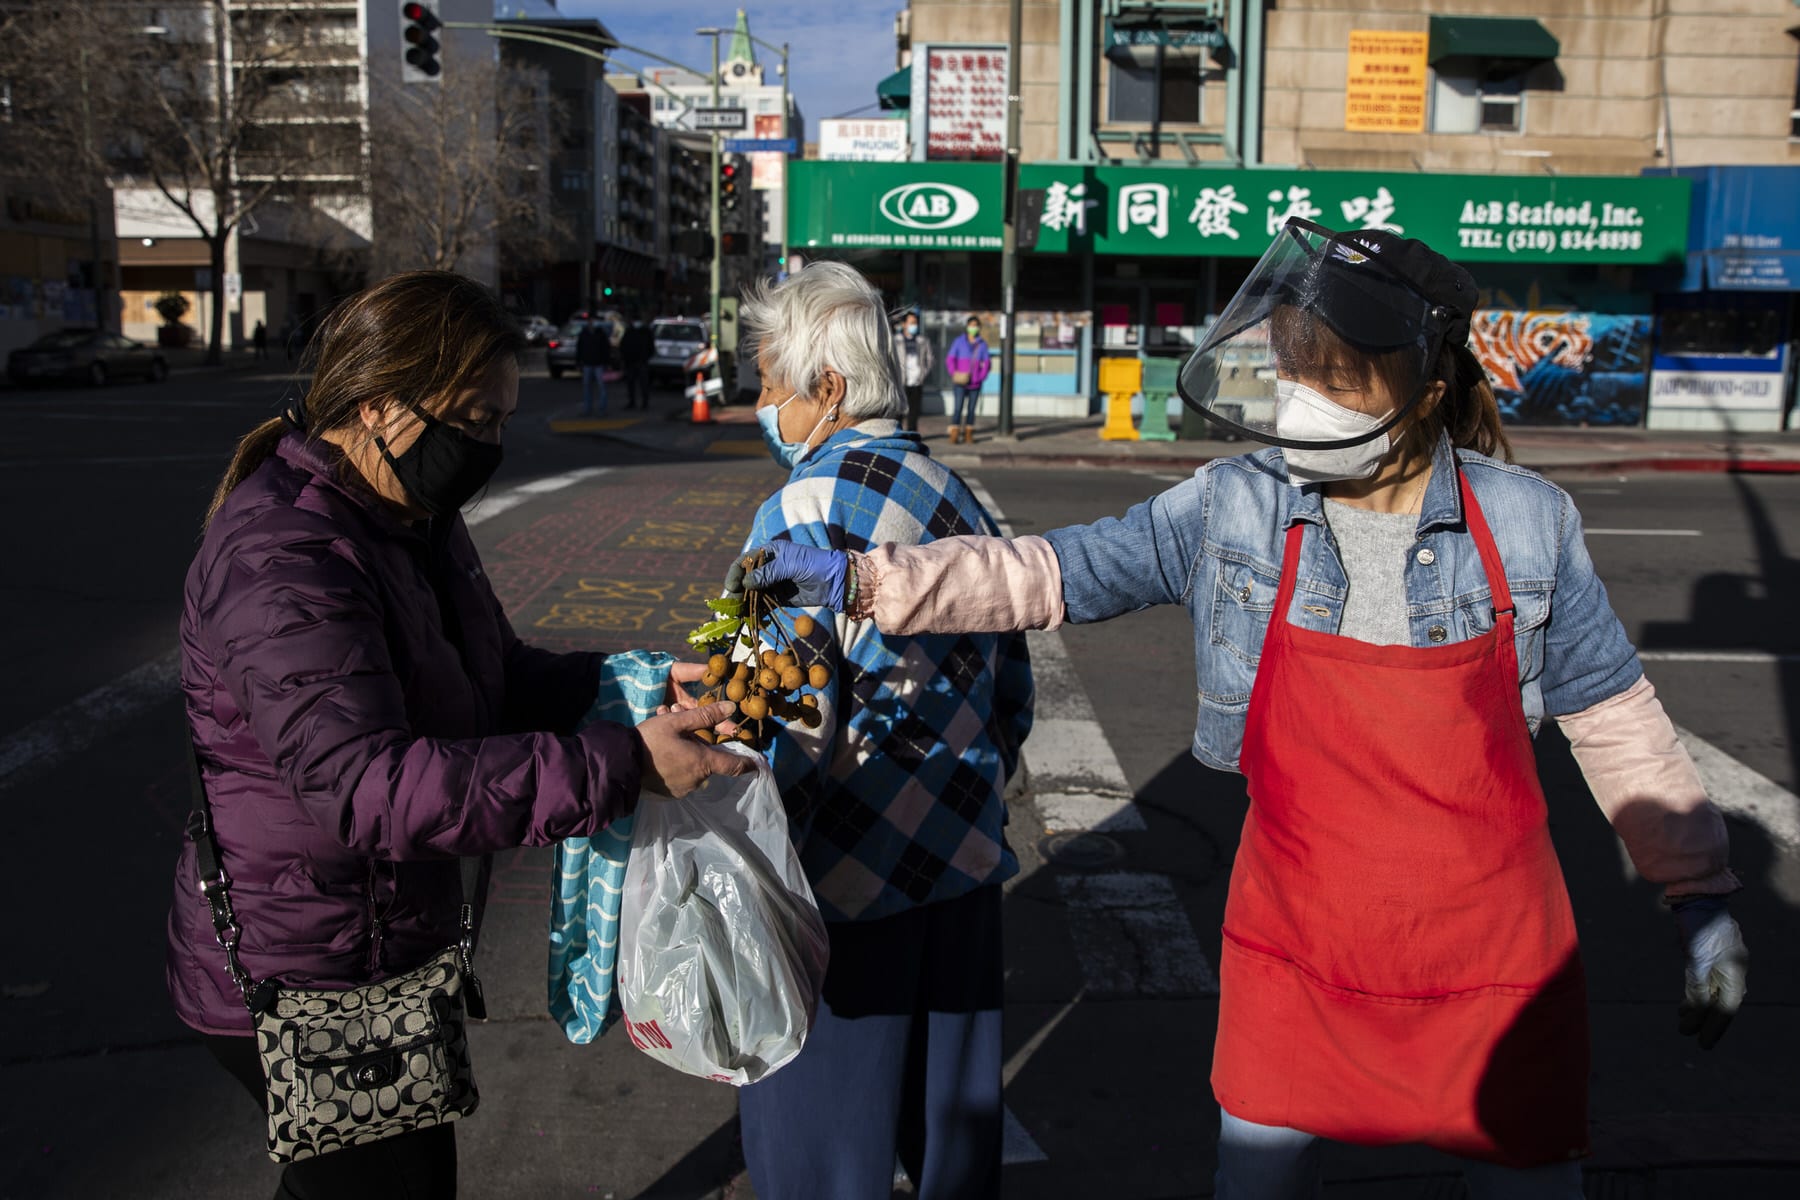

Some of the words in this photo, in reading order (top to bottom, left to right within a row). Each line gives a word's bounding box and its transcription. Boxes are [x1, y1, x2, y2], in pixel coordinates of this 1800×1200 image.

[908, 194, 950, 217] AB
[1459, 200, 1503, 224] A&B
[1506, 201, 1598, 230] Seafood,
[1601, 203, 1644, 226] Inc.
[1458, 228, 1503, 248] TEL:
[1507, 230, 1556, 253] (510)
